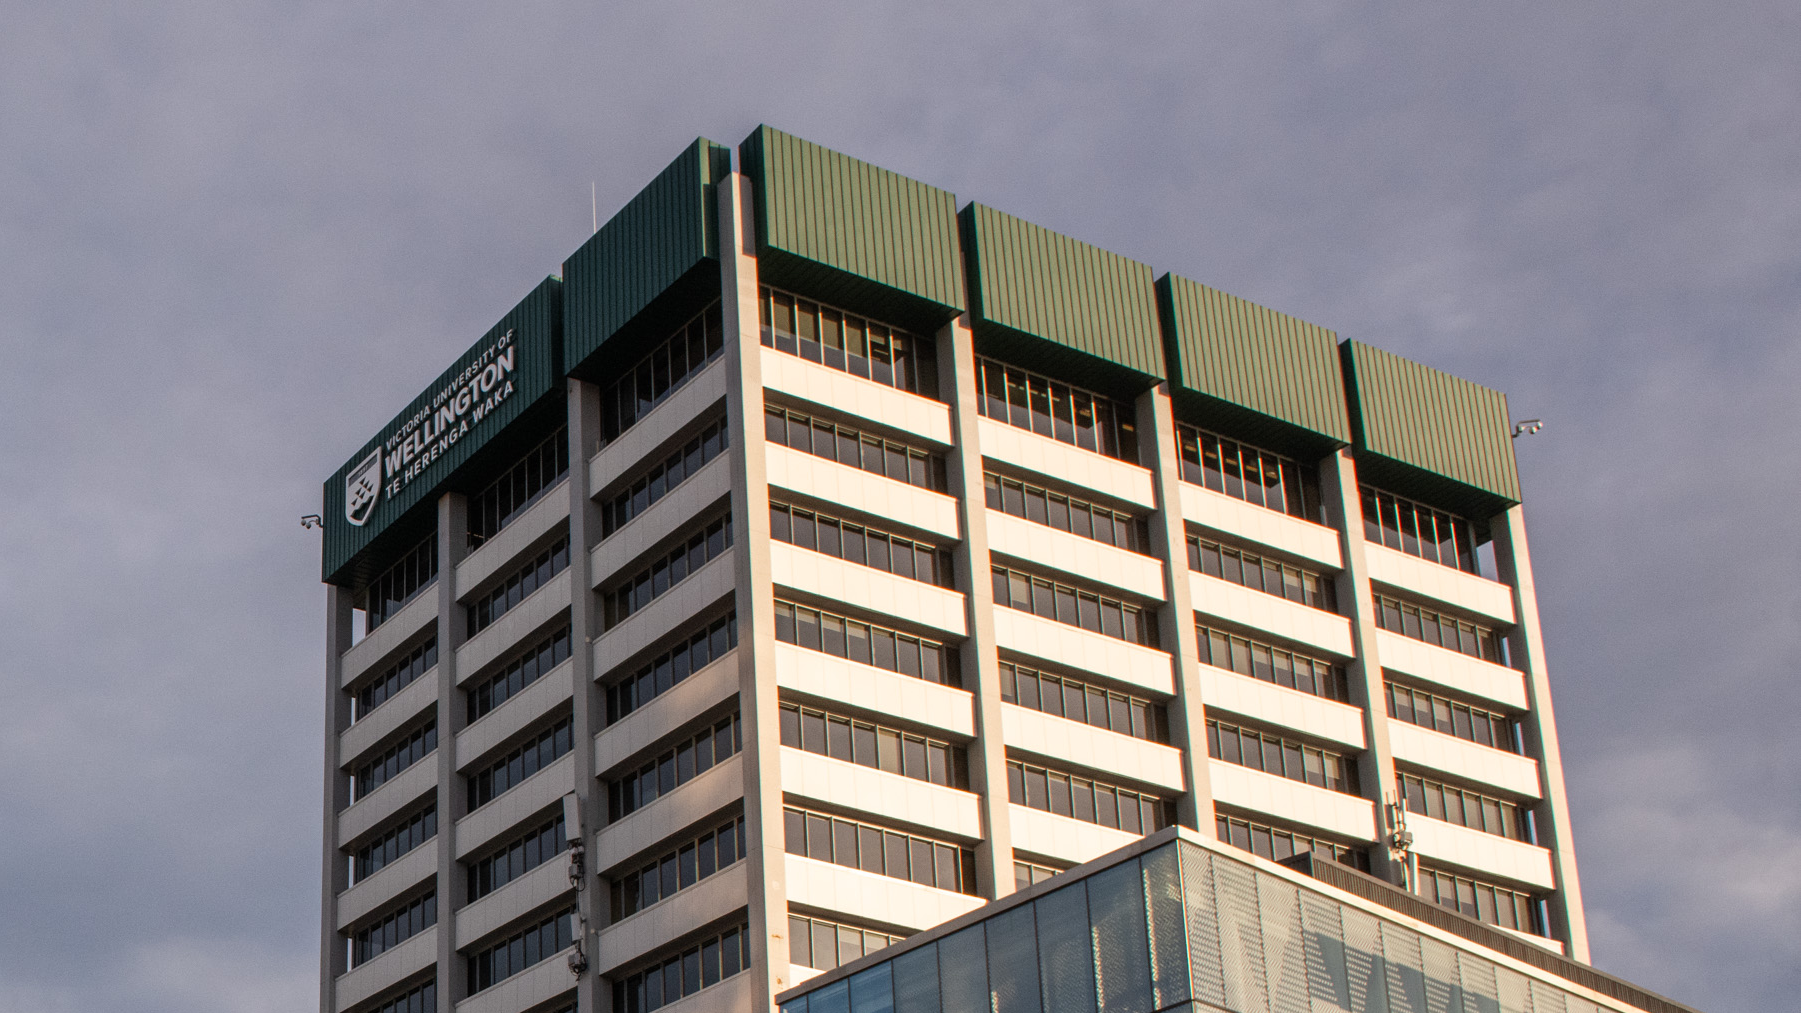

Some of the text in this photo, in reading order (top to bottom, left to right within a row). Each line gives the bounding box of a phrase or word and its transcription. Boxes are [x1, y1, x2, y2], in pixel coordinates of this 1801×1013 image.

[385, 345, 515, 478] WELLINGTON
[385, 380, 515, 499] TE HERENGA WAKA
[386, 328, 514, 450] VICTORIA UNIVERSITY OF
